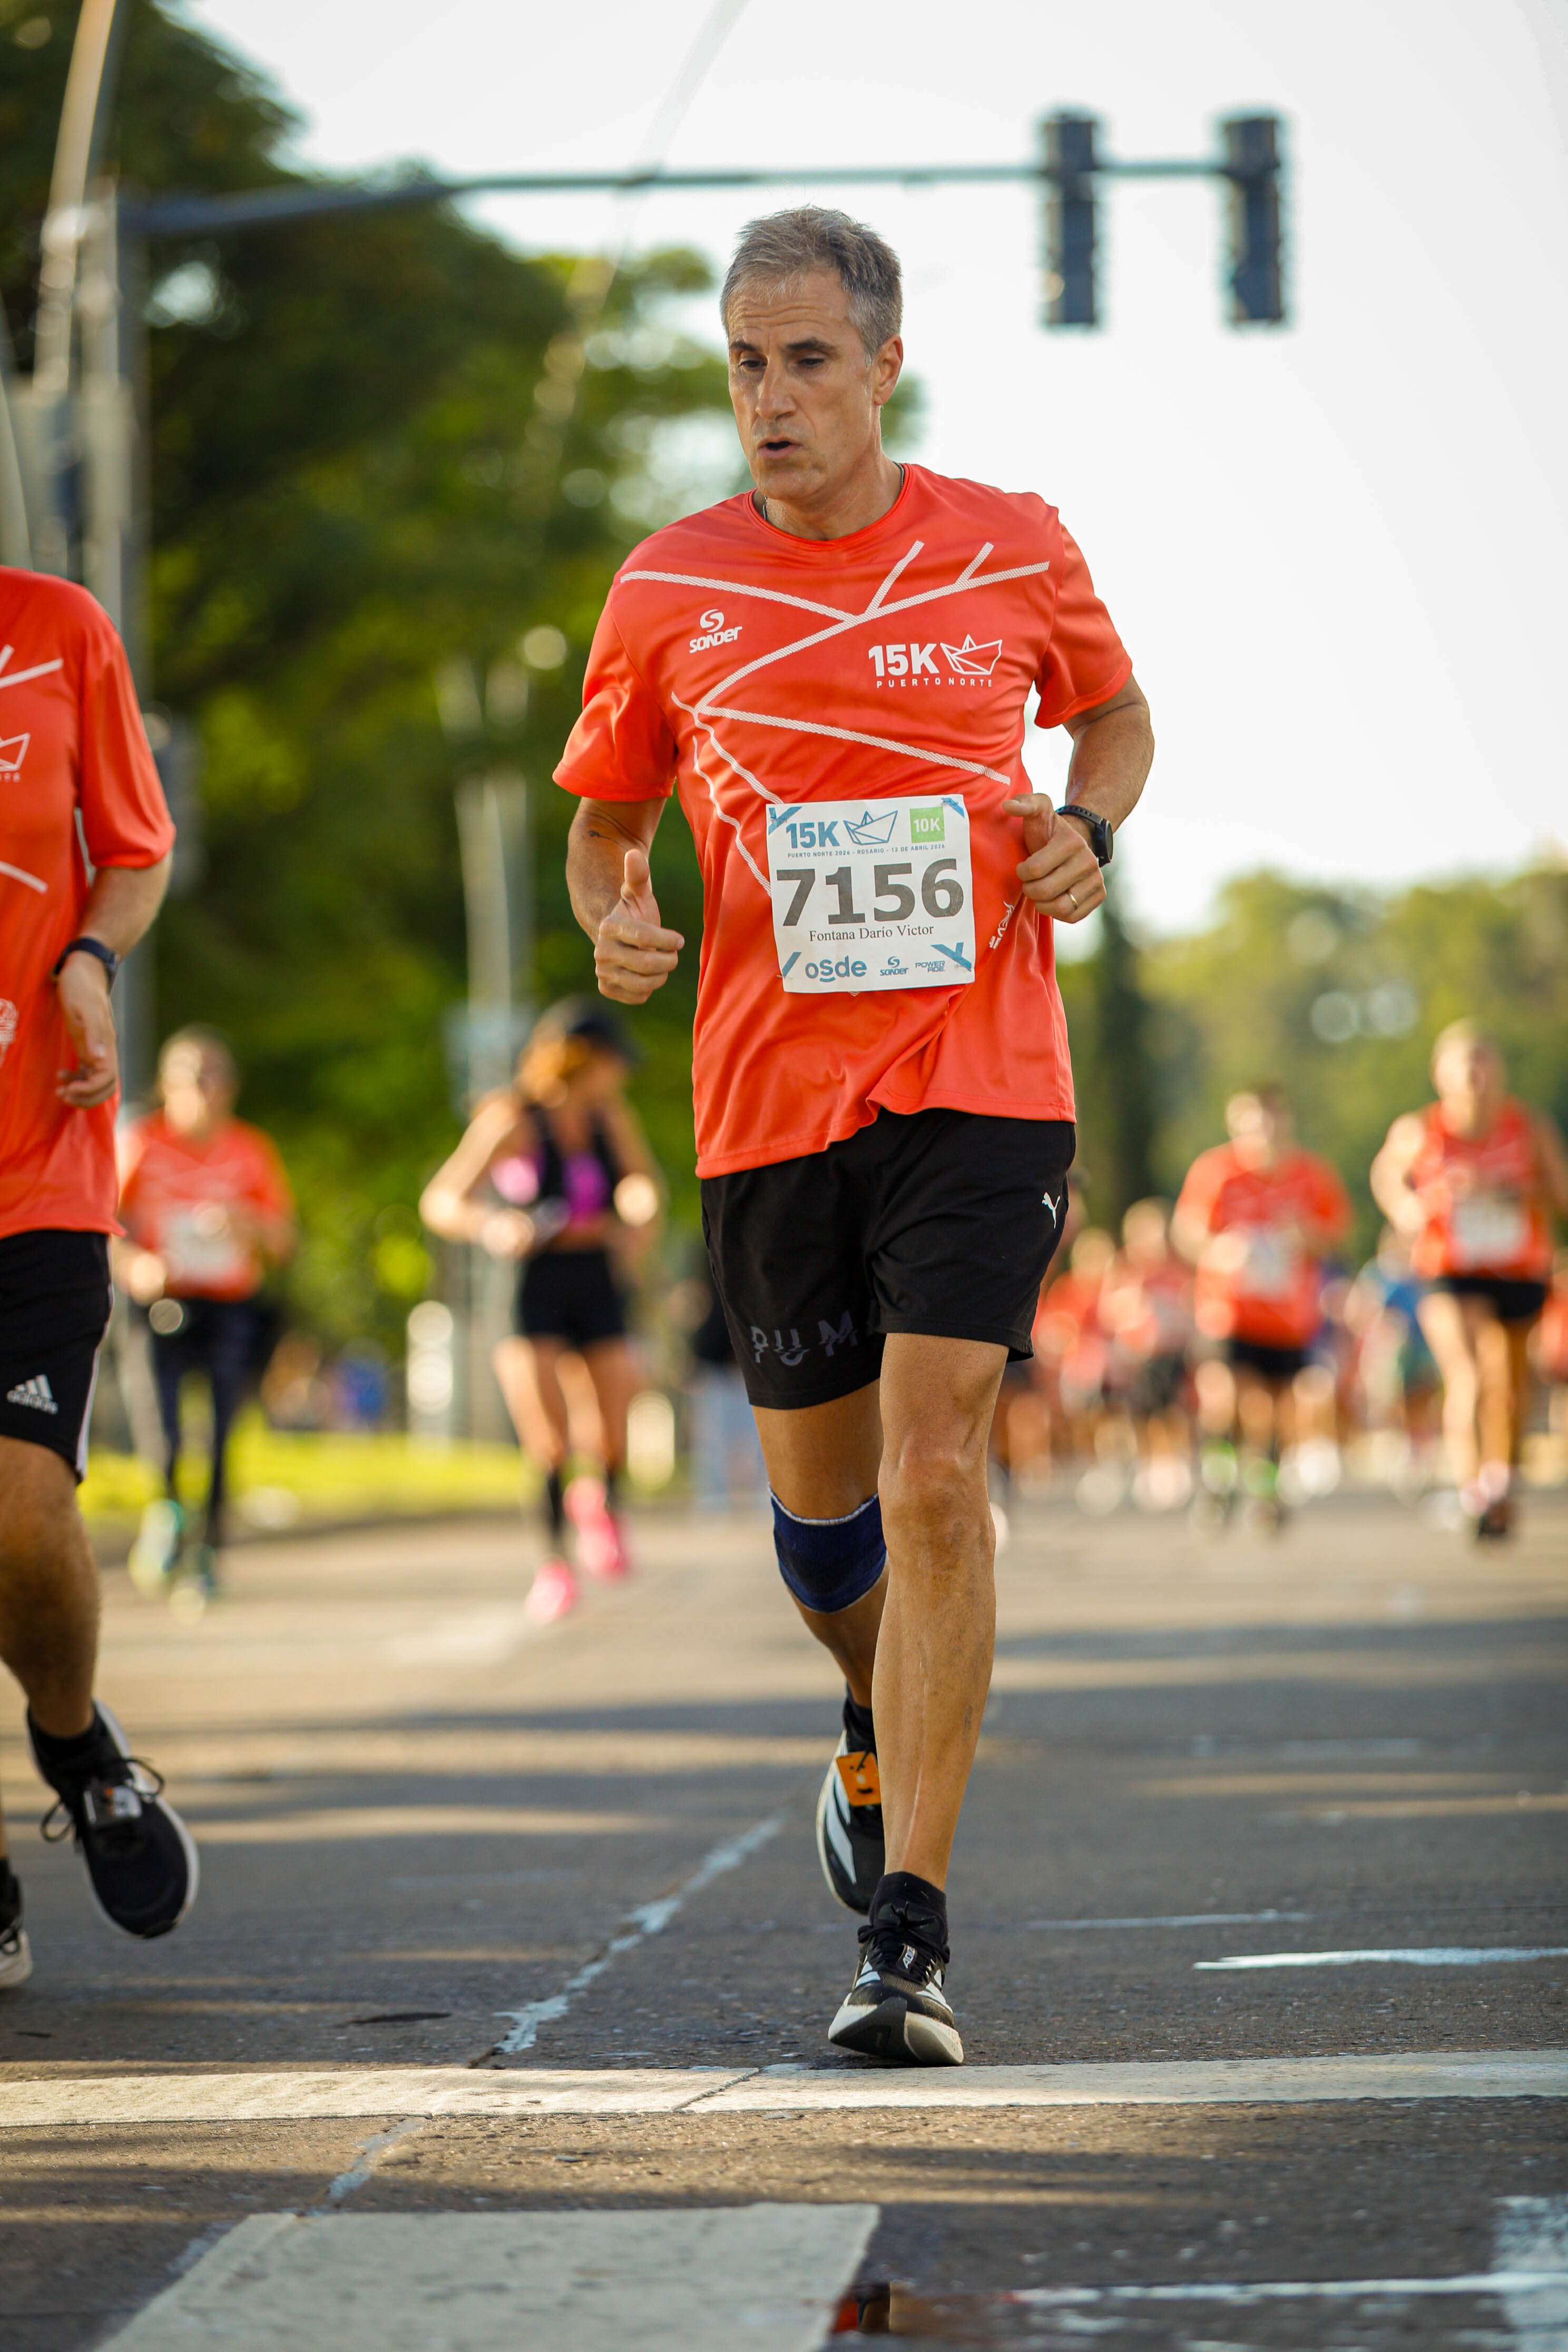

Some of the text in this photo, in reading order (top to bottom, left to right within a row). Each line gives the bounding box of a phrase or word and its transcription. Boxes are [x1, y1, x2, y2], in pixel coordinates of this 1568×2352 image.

[868, 643, 939, 677] 15K
[876, 678, 992, 688] PUERTO NORTE
[786, 820, 840, 849] 15K
[914, 817, 941, 833] 10K
[776, 858, 964, 927] 7156
[809, 924, 934, 942] Fontana Darío Victor
[805, 955, 867, 981] osde
